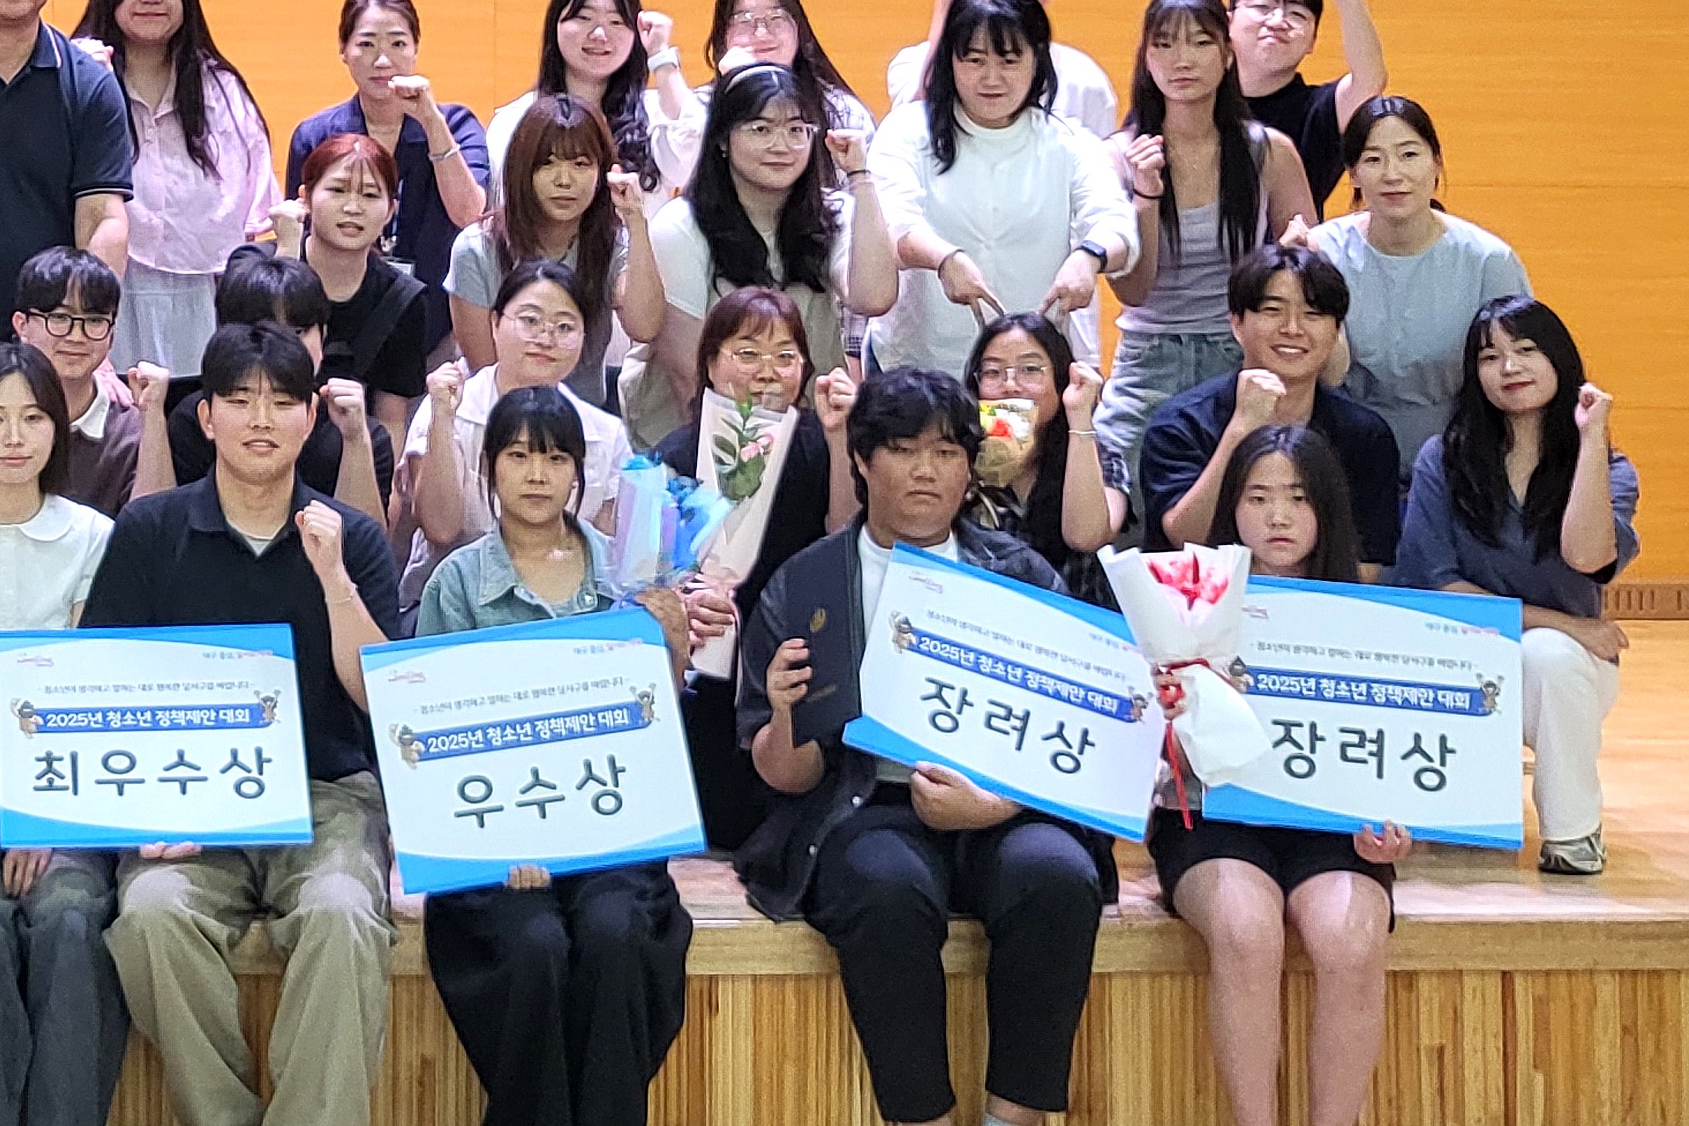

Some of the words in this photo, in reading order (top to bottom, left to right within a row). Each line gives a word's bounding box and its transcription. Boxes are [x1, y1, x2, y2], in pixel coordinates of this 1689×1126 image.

[46, 710, 104, 728] 2025년
[106, 709, 152, 728] 청소년
[219, 707, 250, 723] 대회
[427, 731, 484, 753] 2025년
[486, 722, 533, 746] 청소년
[598, 707, 629, 727] 대회
[919, 676, 1096, 774] 장려상
[33, 746, 273, 799] 최우수상
[1271, 718, 1457, 792] 장려상
[453, 754, 626, 828] 우수상
